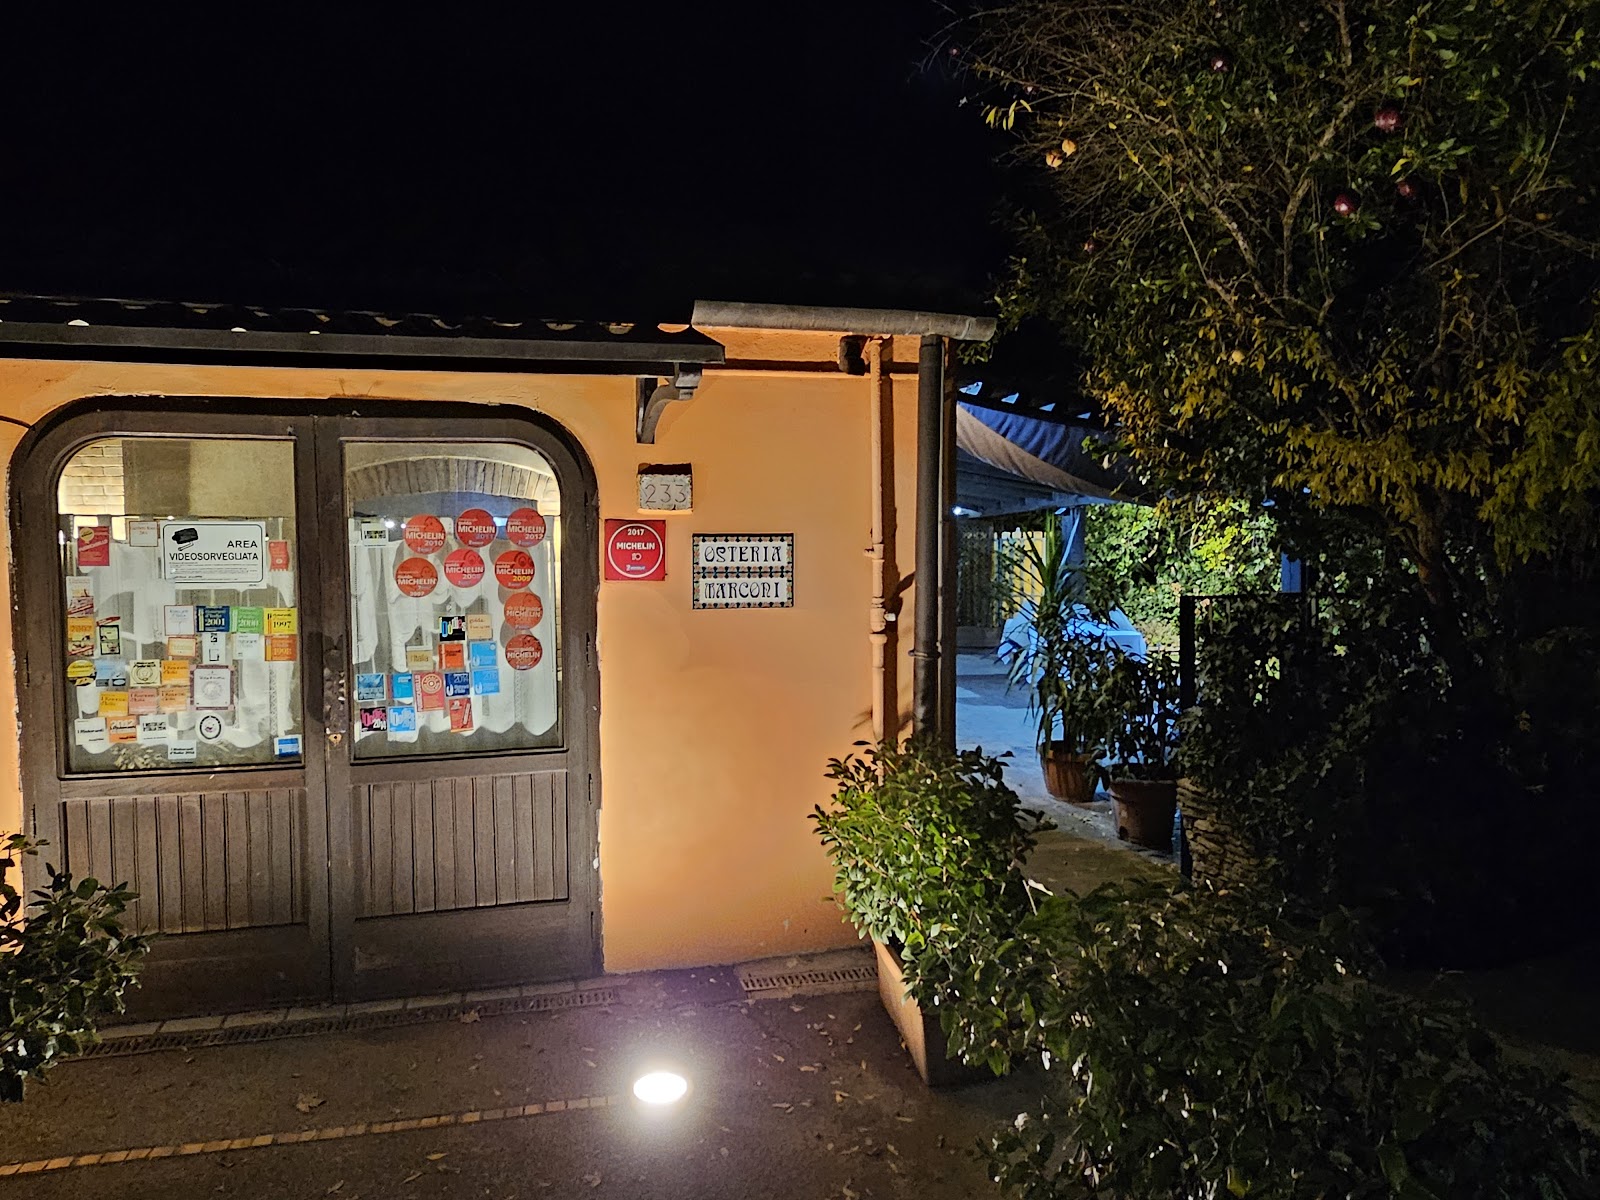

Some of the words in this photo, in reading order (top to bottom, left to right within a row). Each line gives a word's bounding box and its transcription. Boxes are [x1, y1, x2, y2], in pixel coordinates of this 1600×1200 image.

[645, 483, 687, 504] 233
[457, 525, 496, 534] MICHELIN
[507, 525, 545, 534] MICHELIN
[627, 528, 645, 536] 2017
[405, 531, 445, 540] MICHELIN
[227, 540, 258, 549] AREA
[616, 542, 656, 550] MICHELIN
[169, 552, 259, 561] VIDEOSORVEGLIATA
[704, 545, 782, 563] OSTERIA
[445, 566, 484, 574] MICHELIN
[704, 582, 780, 599] MARCONI
[506, 610, 541, 618] MICHELIN
[205, 617, 225, 626] 2001
[273, 620, 292, 629] 1997
[507, 651, 540, 659] MICHELIN
